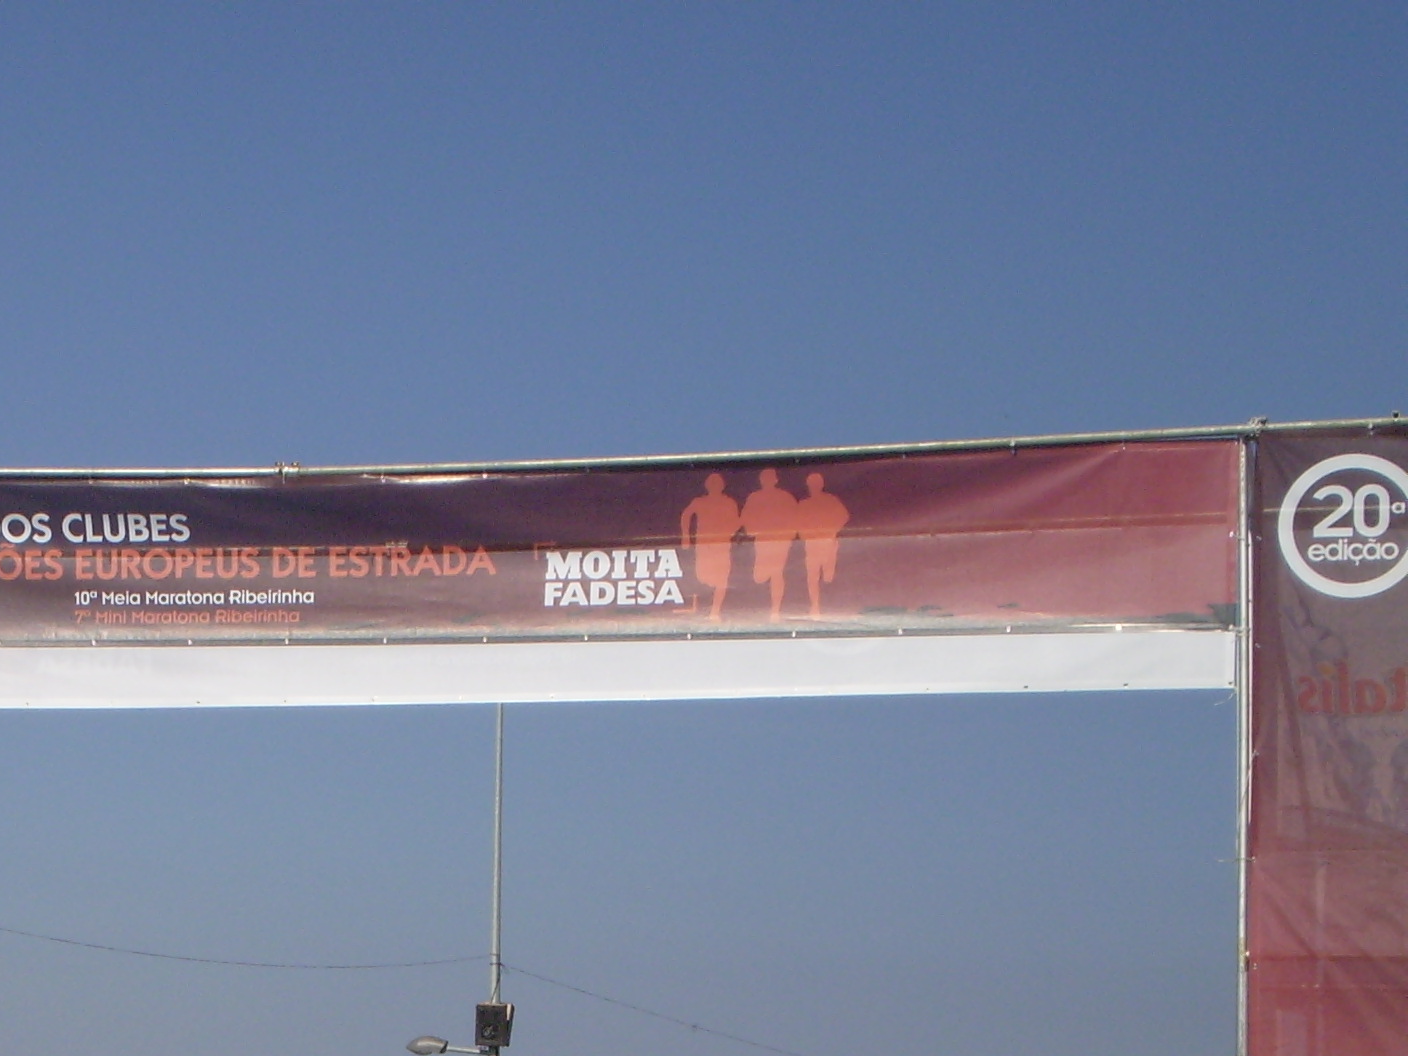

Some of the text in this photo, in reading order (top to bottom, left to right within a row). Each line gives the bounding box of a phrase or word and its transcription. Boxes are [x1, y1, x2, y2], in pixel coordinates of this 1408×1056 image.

[61, 513, 190, 542] CLUBES
[75, 547, 259, 579] EUROPEUS
[271, 547, 315, 579] DE
[328, 545, 497, 577] ESTRADA
[545, 549, 683, 580] MOITA
[1307, 538, 1399, 566] edição
[102, 591, 141, 606] Meia
[145, 590, 225, 605] Maratona
[228, 589, 315, 605] Ribeirinha
[544, 580, 684, 606] FADESA
[95, 610, 127, 624] Mini
[131, 609, 210, 624] Maratona
[215, 609, 300, 623] Ribeirinha
